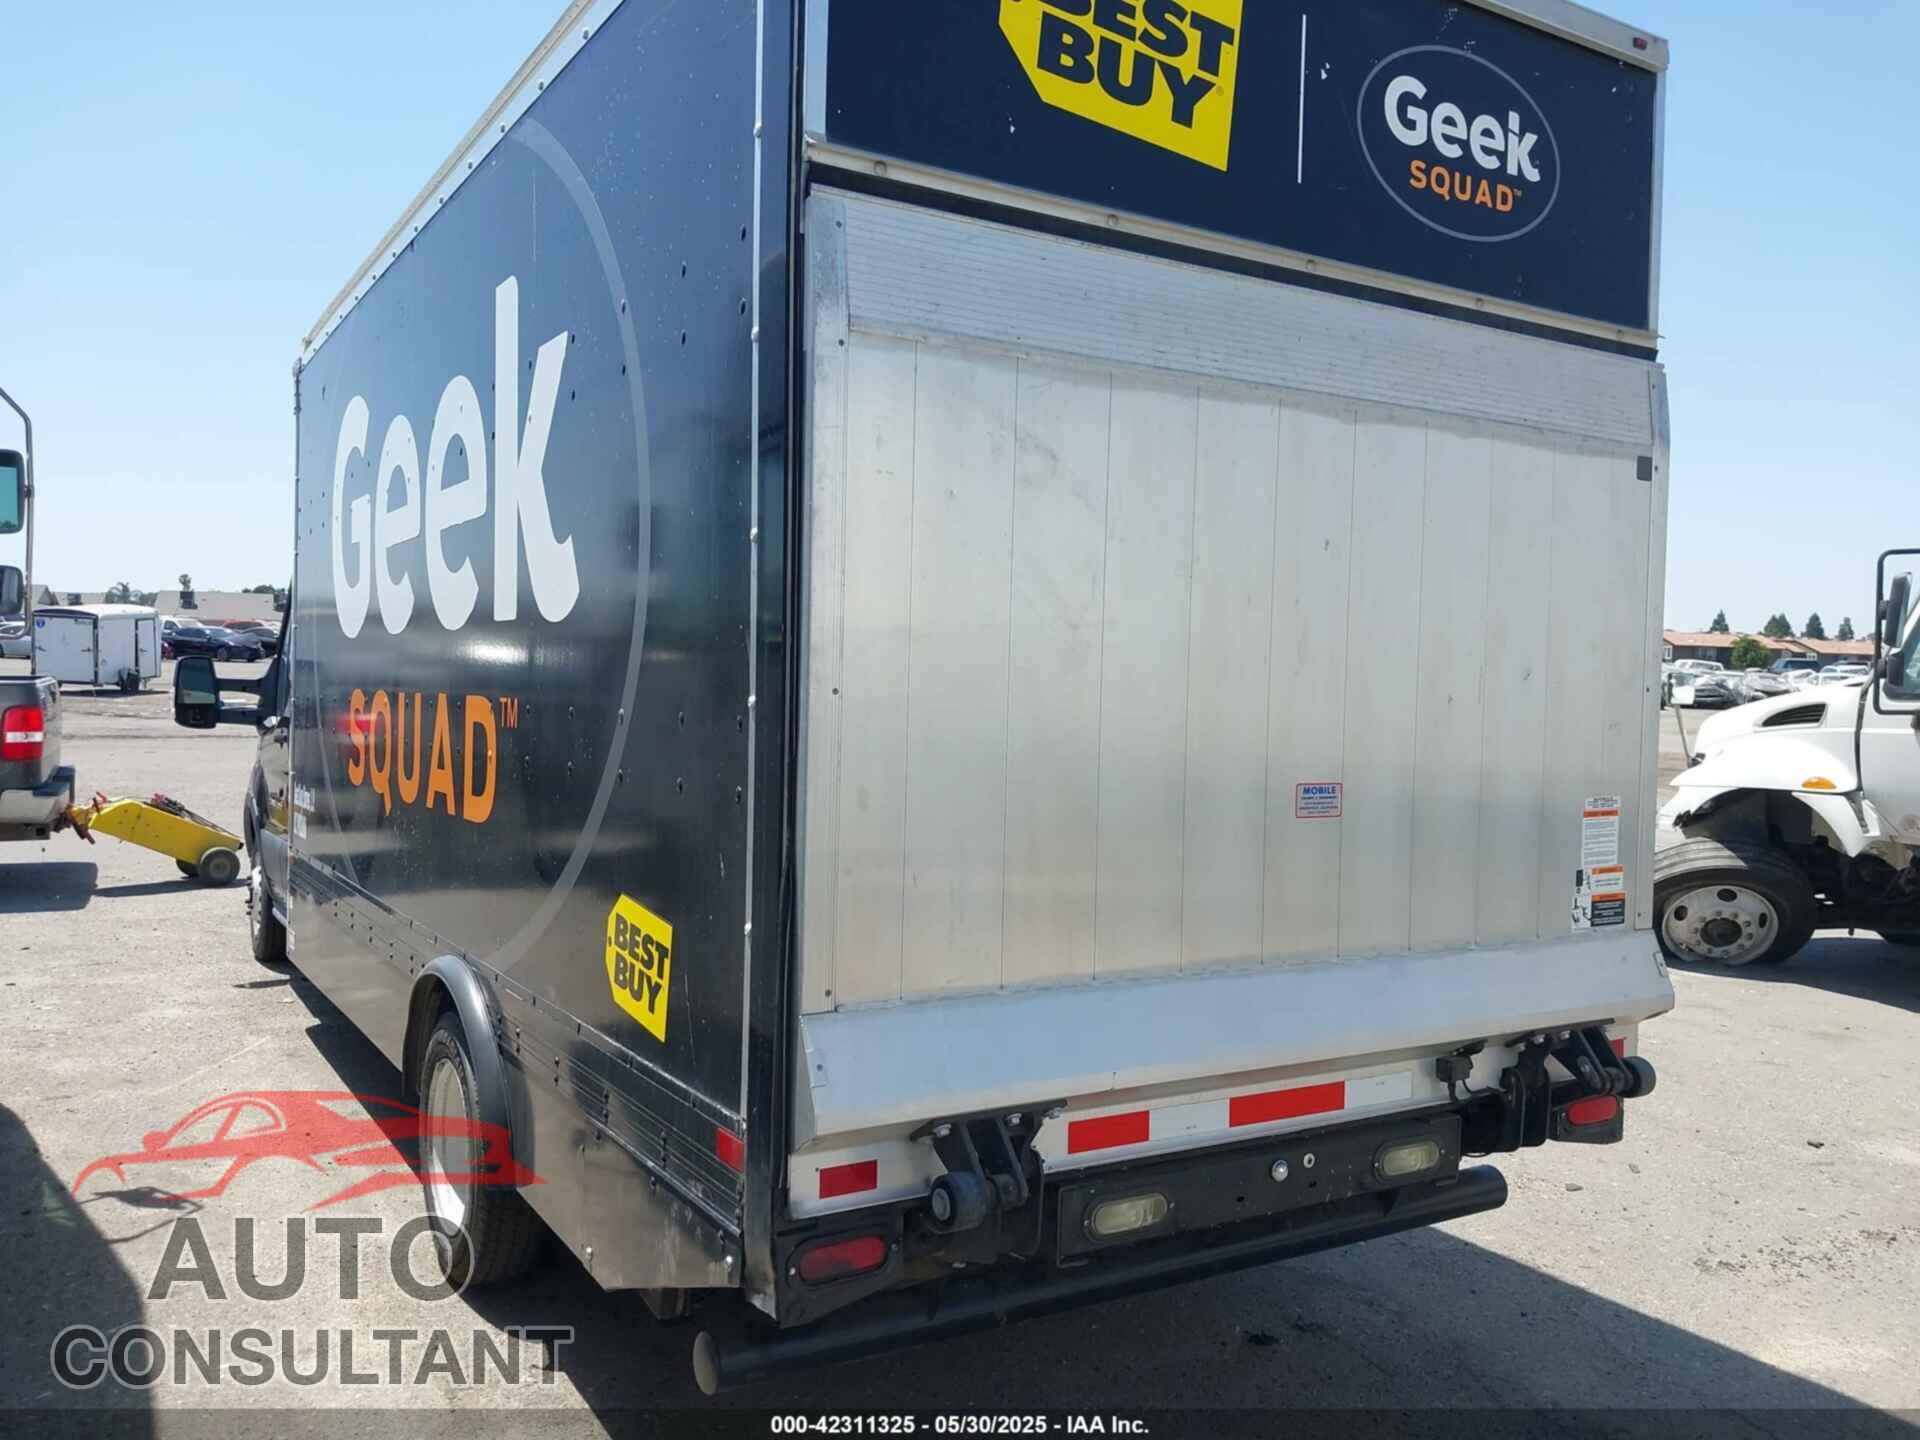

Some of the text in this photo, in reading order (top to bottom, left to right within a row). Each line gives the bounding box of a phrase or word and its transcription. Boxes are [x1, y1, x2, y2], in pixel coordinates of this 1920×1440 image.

[1037, 11, 1216, 129] BUY
[1384, 75, 1541, 182] Geek
[332, 275, 580, 638] Geek
[1303, 786, 1336, 795] MOBILE
[614, 913, 669, 980] BEST
[614, 951, 662, 1015] BUY
